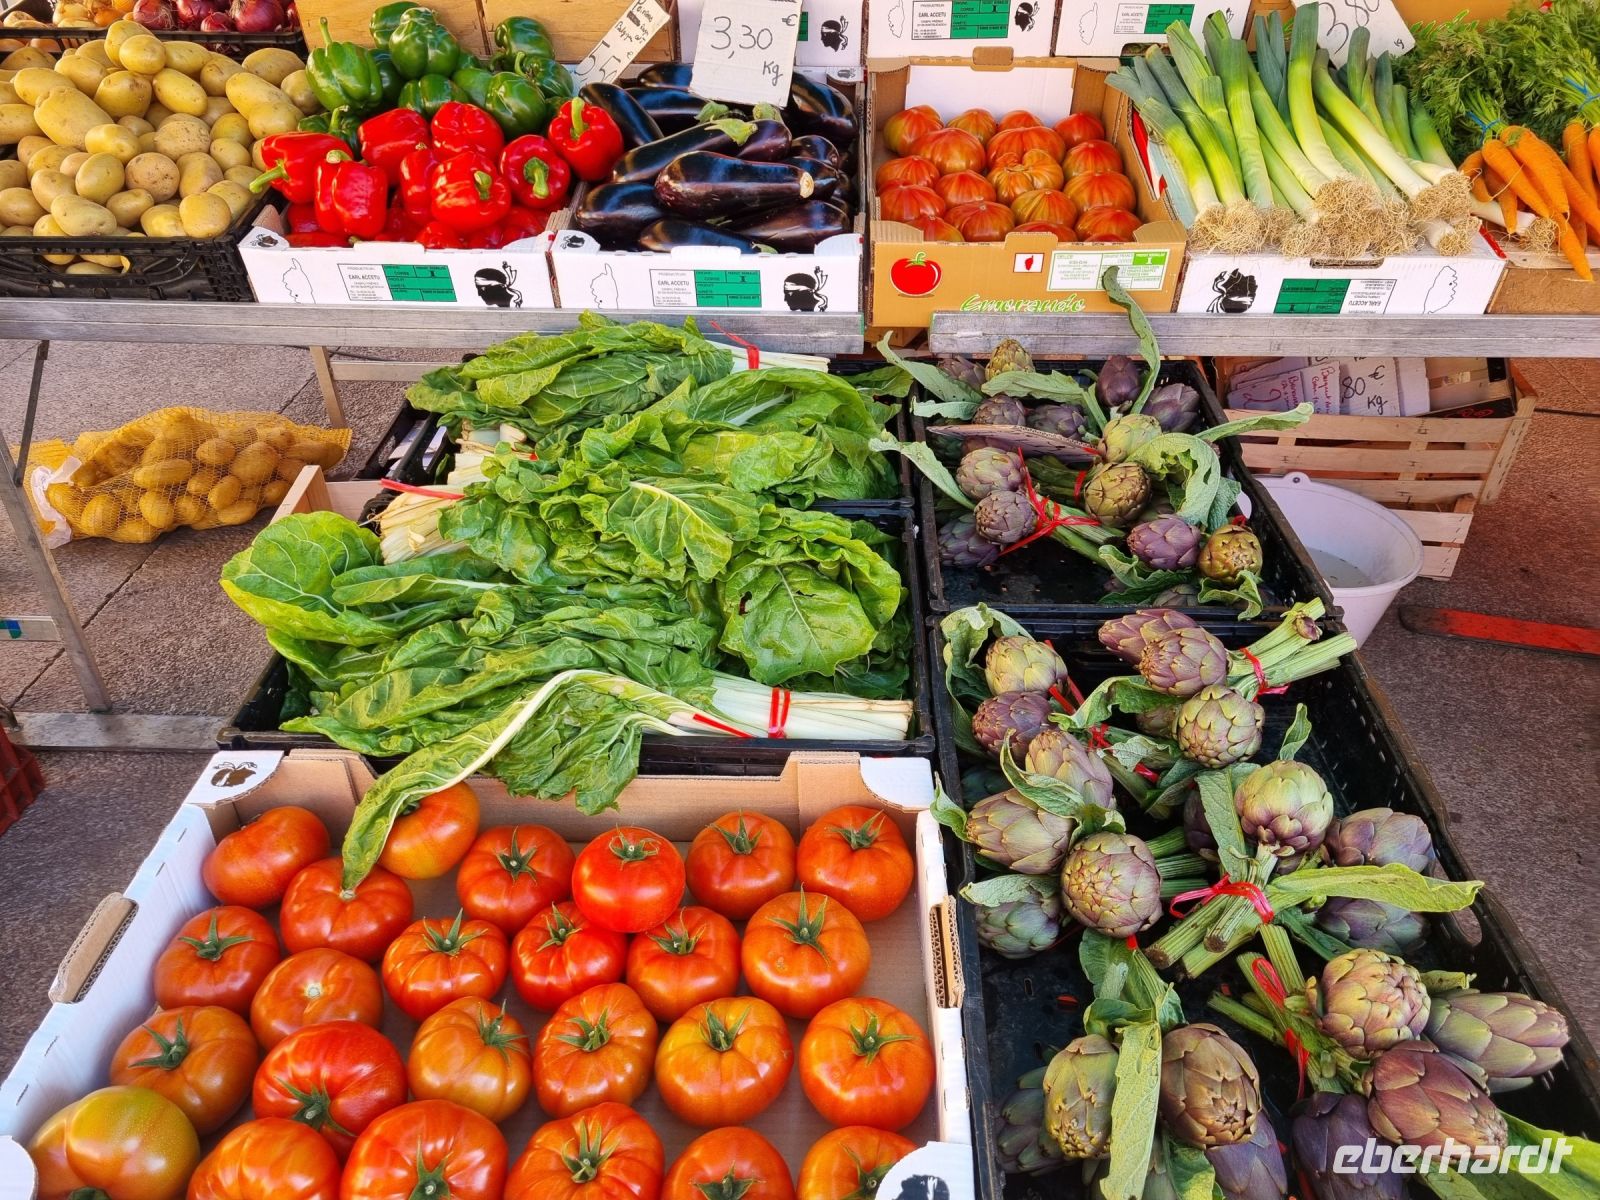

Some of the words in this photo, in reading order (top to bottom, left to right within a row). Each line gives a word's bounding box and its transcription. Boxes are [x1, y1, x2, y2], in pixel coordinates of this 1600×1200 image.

[710, 16, 773, 59] 3,30
[782, 14, 798, 26] €
[1368, 395, 1388, 415] Kg
